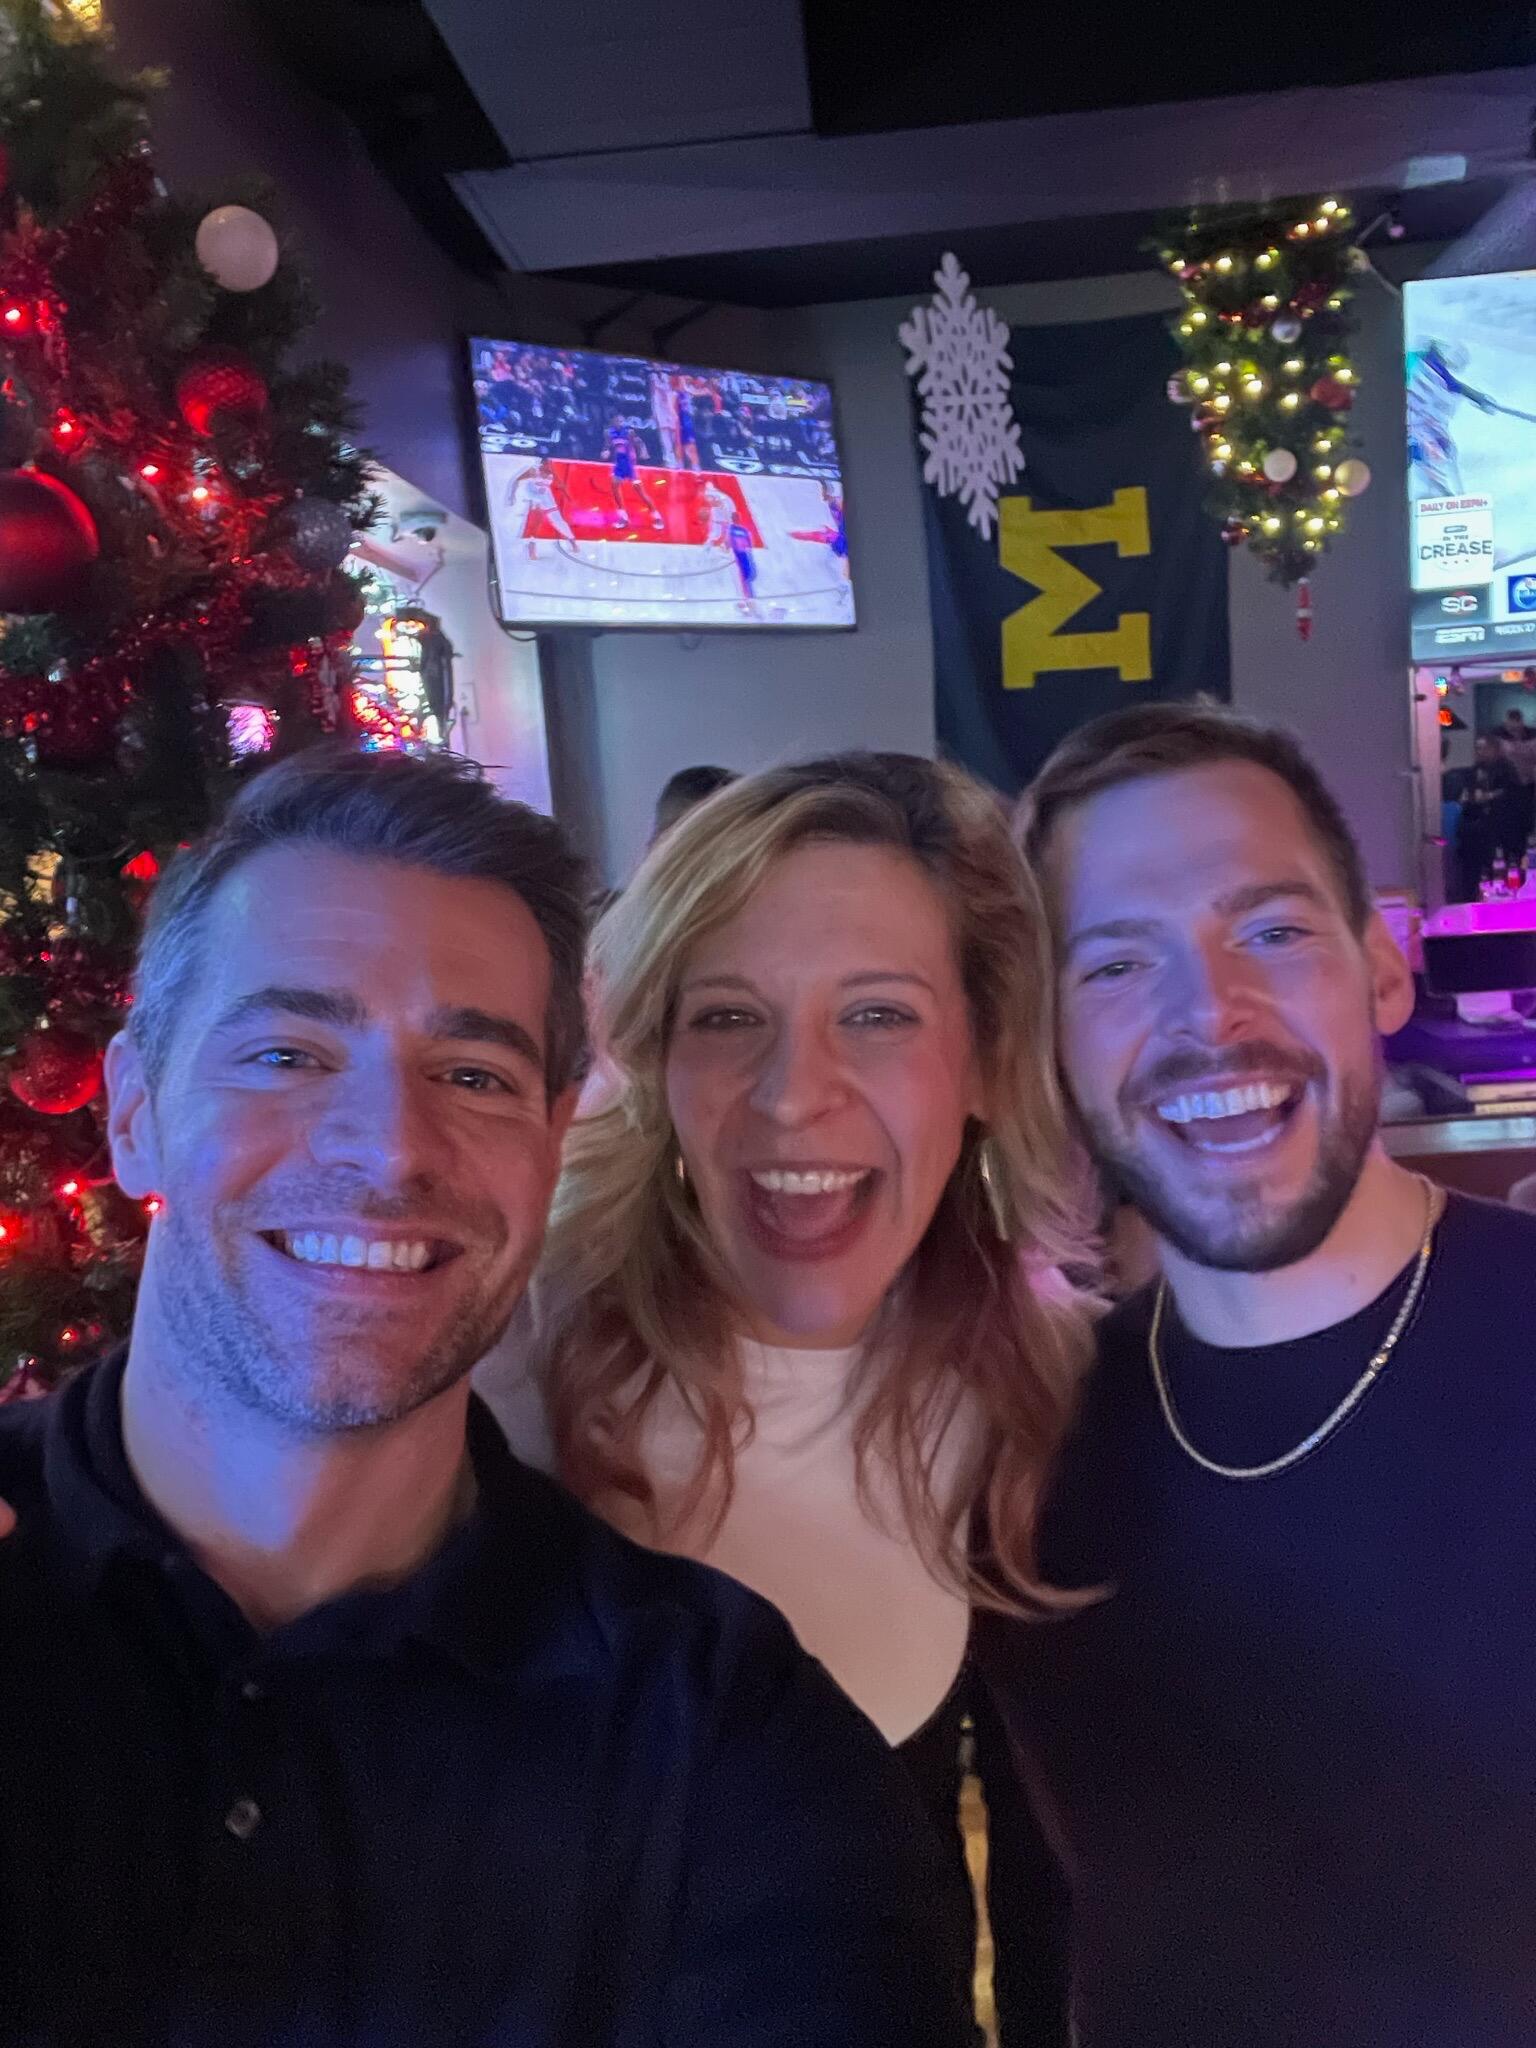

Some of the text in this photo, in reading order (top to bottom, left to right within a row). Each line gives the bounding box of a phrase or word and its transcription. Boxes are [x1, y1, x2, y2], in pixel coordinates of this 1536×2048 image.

[1421, 502, 1444, 513] DAILY
[1445, 501, 1459, 510] ON
[1420, 540, 1493, 560] CREASE
[998, 485, 1152, 689] M
[1440, 595, 1478, 613] SC
[1434, 626, 1486, 644] ESPN
